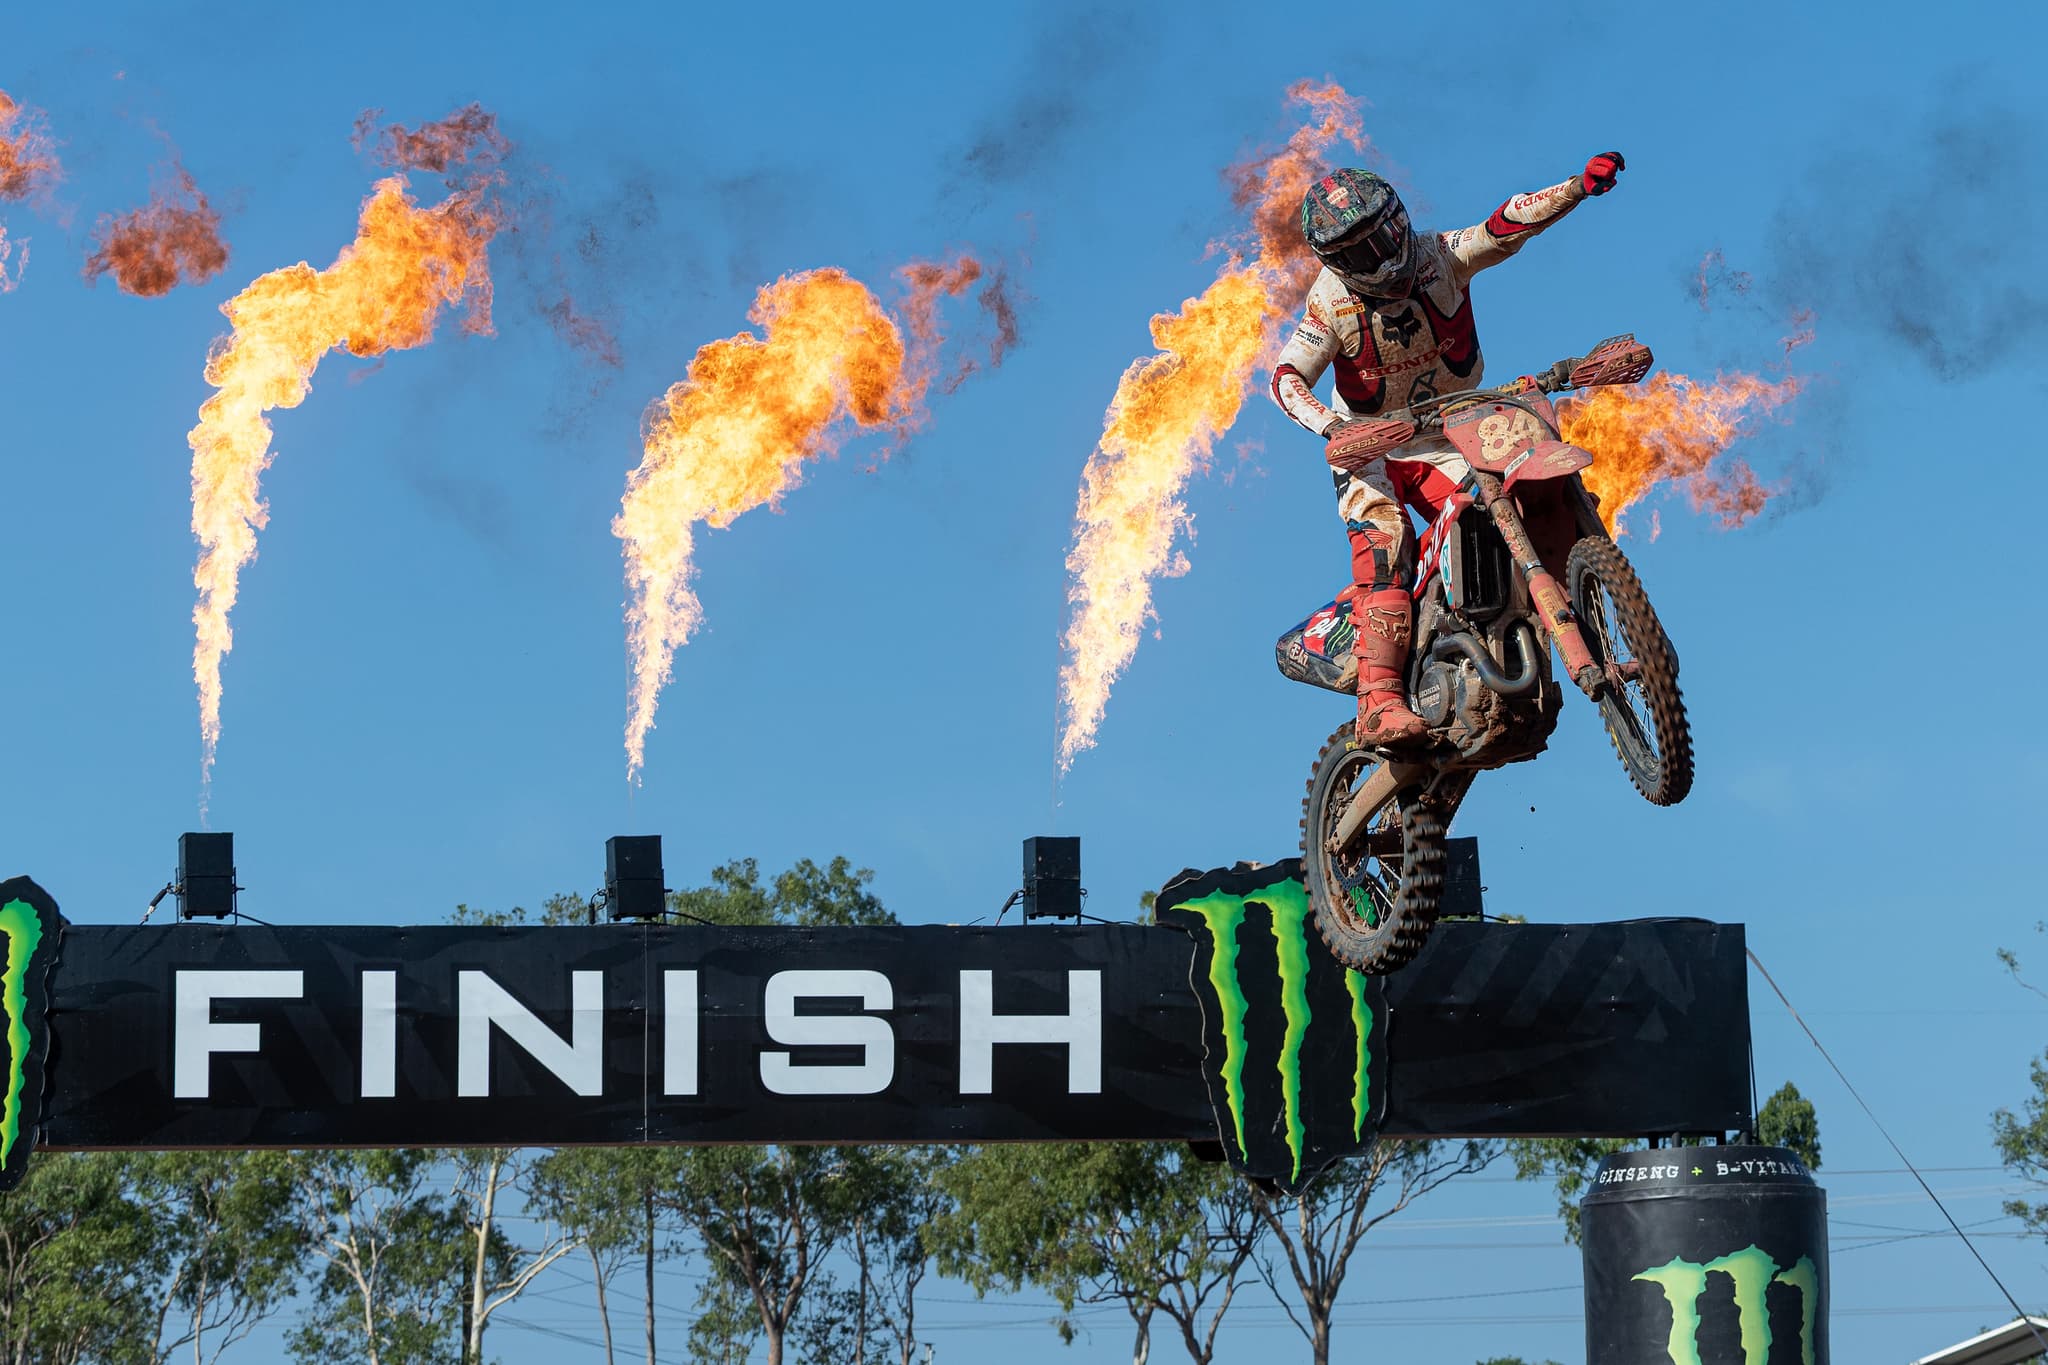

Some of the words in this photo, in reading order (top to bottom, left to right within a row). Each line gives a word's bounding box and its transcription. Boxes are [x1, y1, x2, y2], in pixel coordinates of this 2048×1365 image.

[1513, 184, 1566, 210] HONDA
[1358, 337, 1456, 380] HONDA
[1289, 379, 1327, 416] HONDA
[1329, 436, 1379, 458] ACERBIS
[1477, 407, 1546, 462] 84
[173, 968, 1102, 1098] FINISH
[1599, 1165, 1679, 1185] GINSENG
